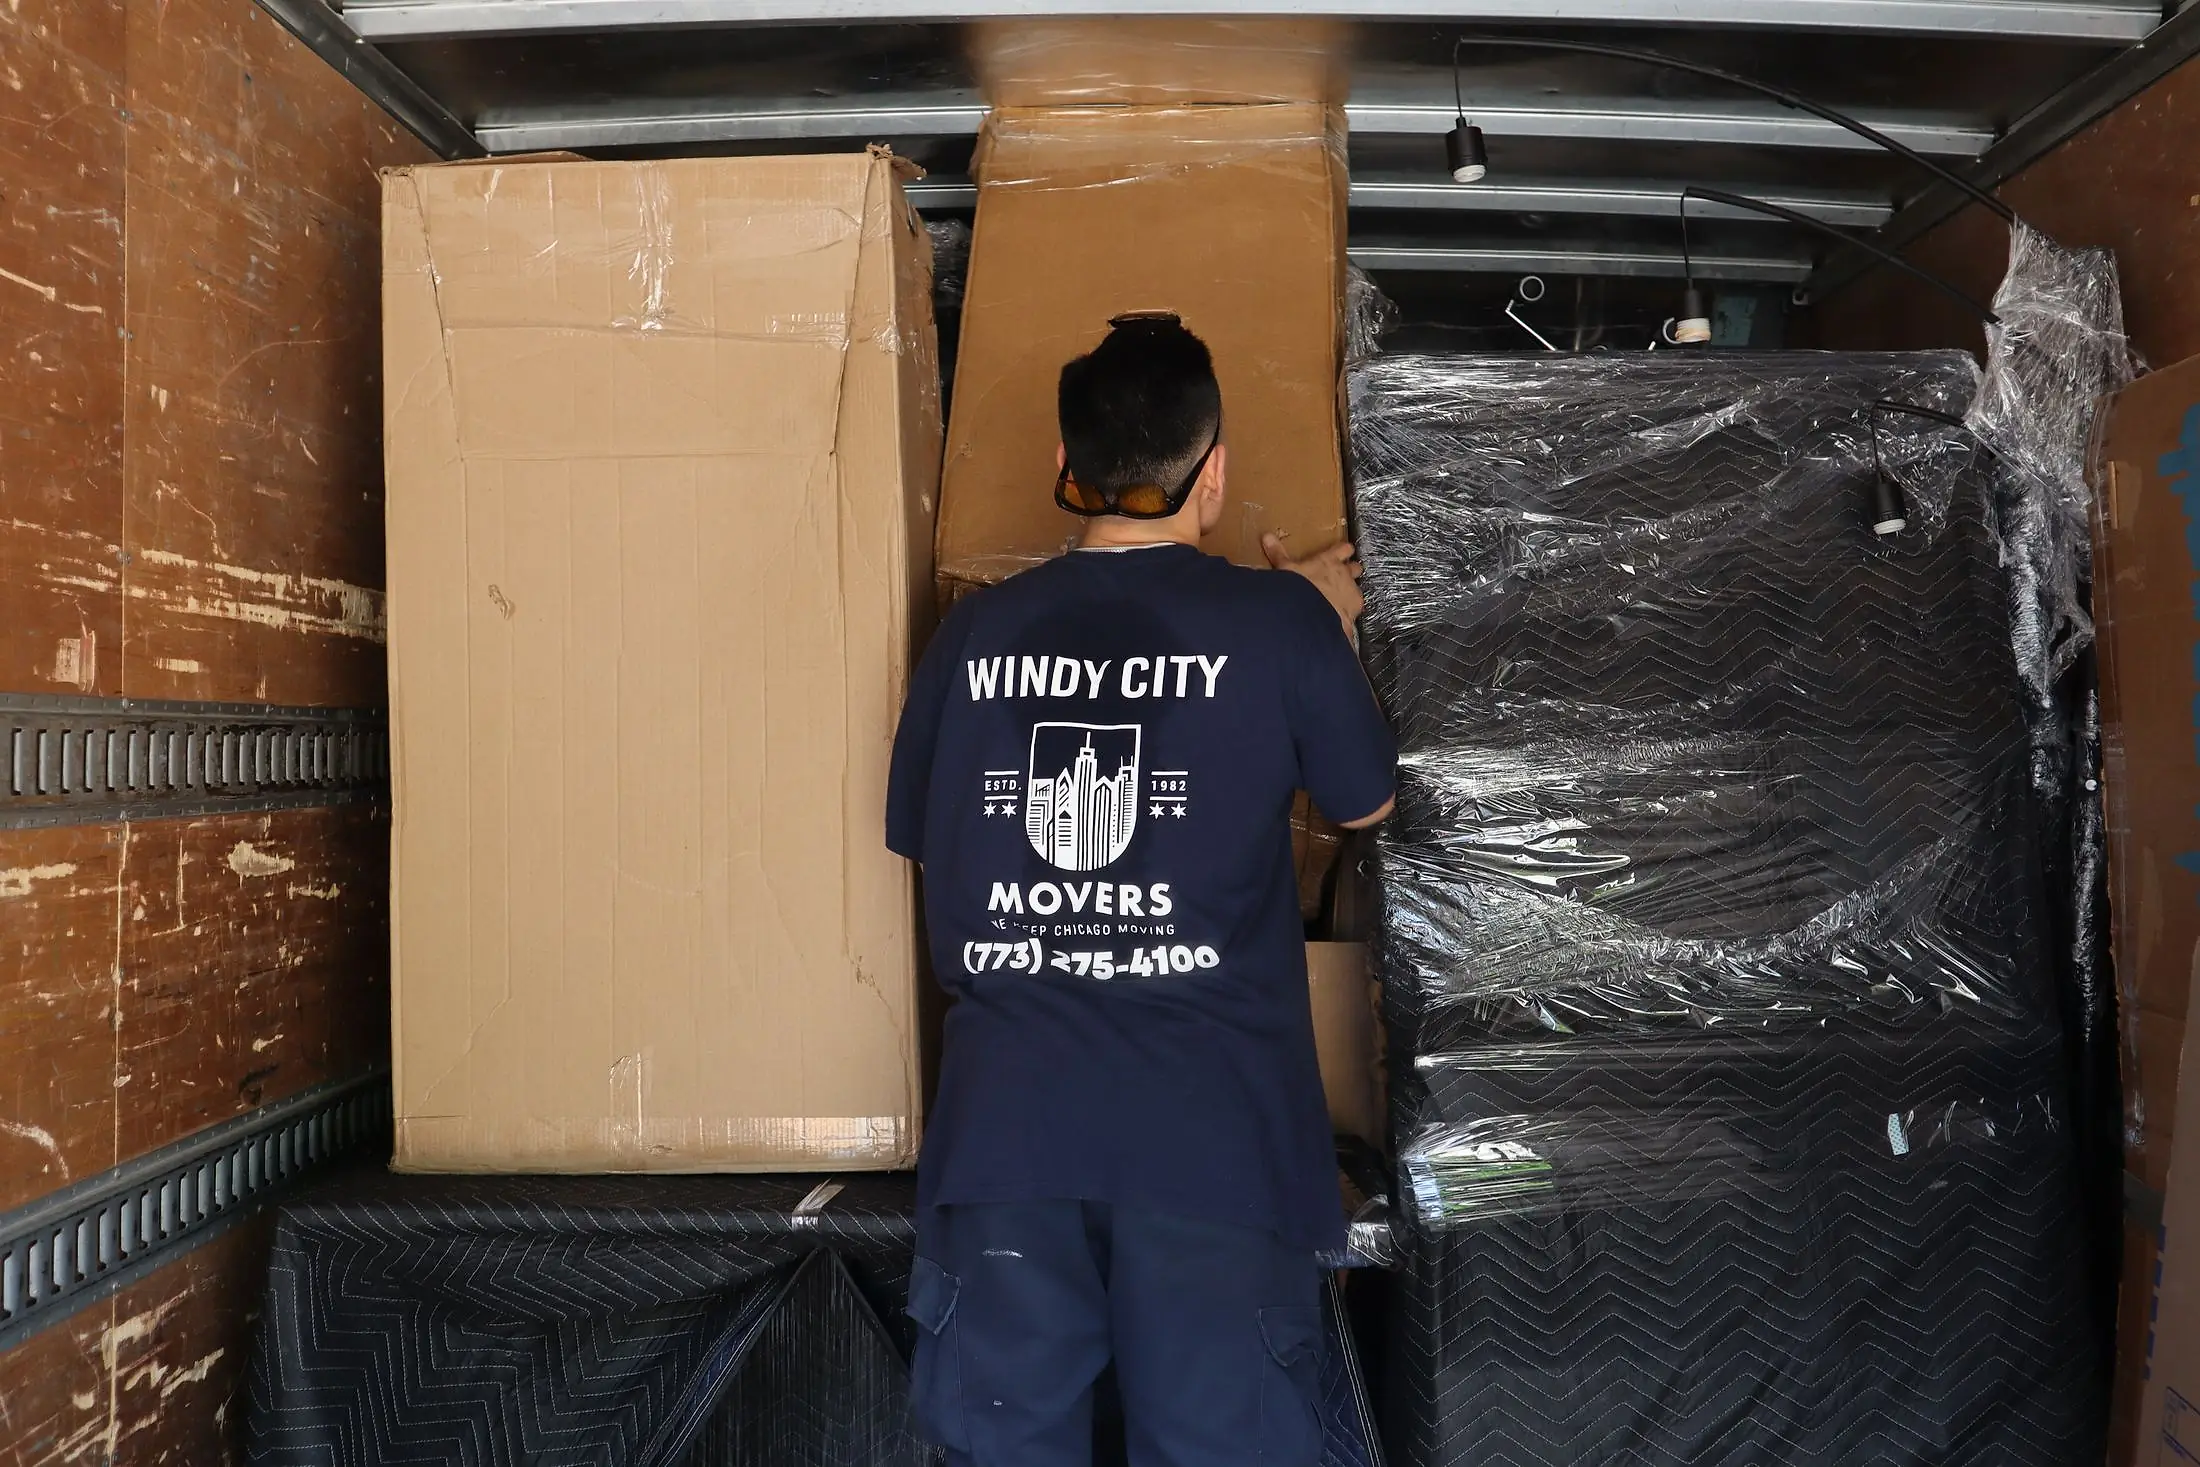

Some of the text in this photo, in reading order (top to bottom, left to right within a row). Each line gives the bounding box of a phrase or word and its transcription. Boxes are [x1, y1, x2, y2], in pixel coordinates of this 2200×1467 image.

[966, 654, 1229, 702] WINDY CITY
[984, 779, 1022, 792] ESTD.
[1151, 779, 1187, 792] 1982
[987, 881, 1173, 917] MOVERS
[1054, 923, 1111, 937] CHICAGO
[1117, 923, 1175, 936] MOVING
[963, 937, 1220, 981] (773) 275-4100
